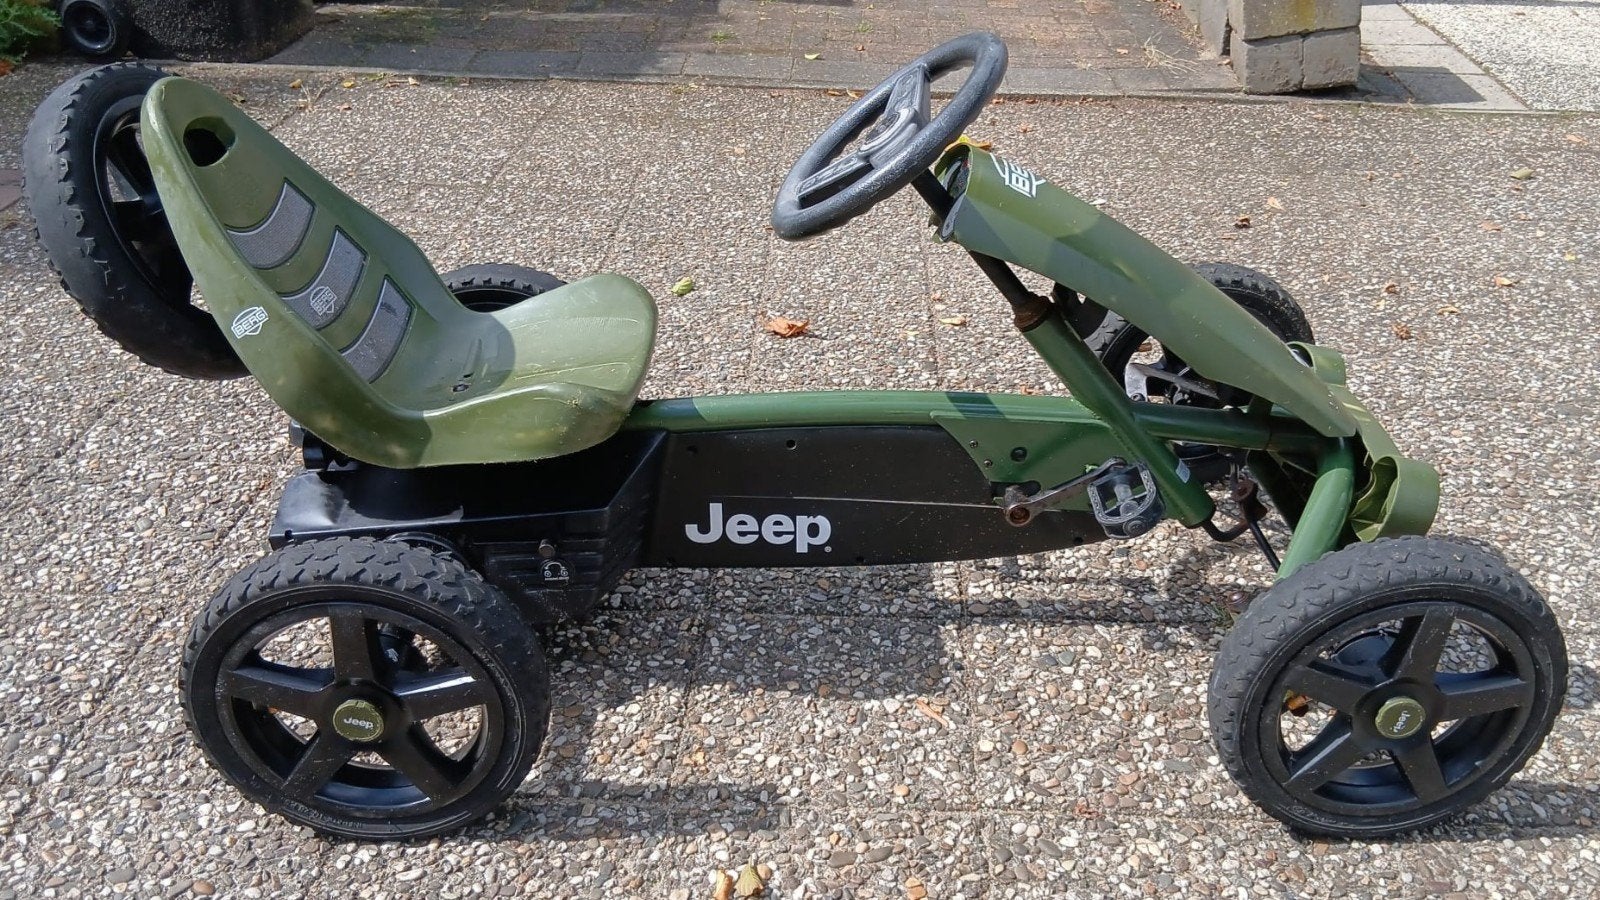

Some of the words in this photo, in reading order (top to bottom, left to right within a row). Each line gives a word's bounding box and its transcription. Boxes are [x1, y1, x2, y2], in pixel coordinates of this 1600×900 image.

[234, 309, 266, 336] BERG
[685, 502, 831, 553] Jeep
[343, 716, 374, 729] Jeep
